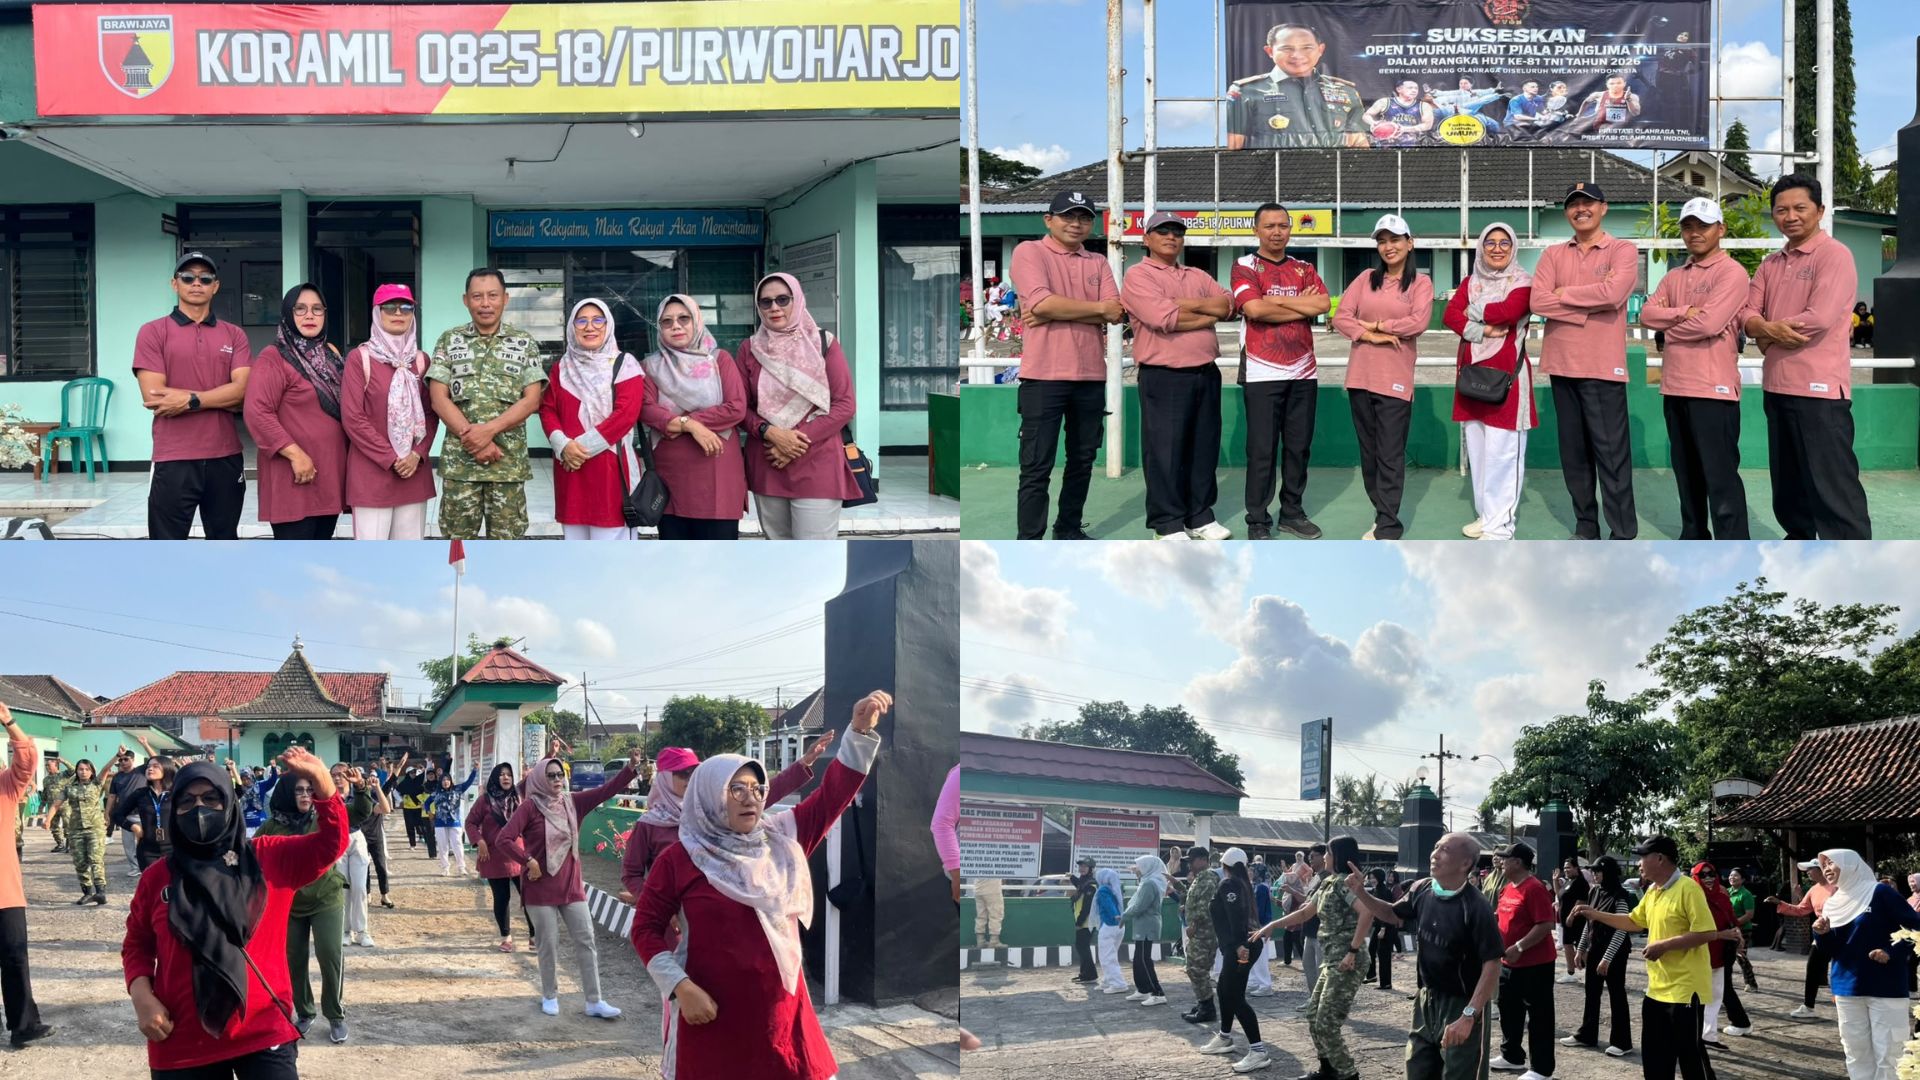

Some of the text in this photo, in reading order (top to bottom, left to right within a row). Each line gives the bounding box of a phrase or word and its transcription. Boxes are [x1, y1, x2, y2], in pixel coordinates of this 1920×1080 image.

[103, 20, 167, 29] BRAWIJAYA
[1426, 28, 1586, 43] SUKSESKAN
[199, 25, 960, 85] KORAMIL 0825-18/PURWOHARJO
[1365, 44, 1657, 56] OPEN TOURNAMENT PIALA PANGLIMA TNI
[1387, 57, 1641, 66] DALAM RANGKA HUT KE-81 TNI TAHUN 2026
[1635, 128, 1675, 136] OLAHRAGA
[1663, 135, 1705, 143] INDONESIA
[495, 217, 535, 238] Cintailah
[594, 216, 624, 237] Maka
[628, 216, 665, 240] Rakyat
[668, 216, 697, 237] Akan
[701, 215, 759, 236] Mencintaimu
